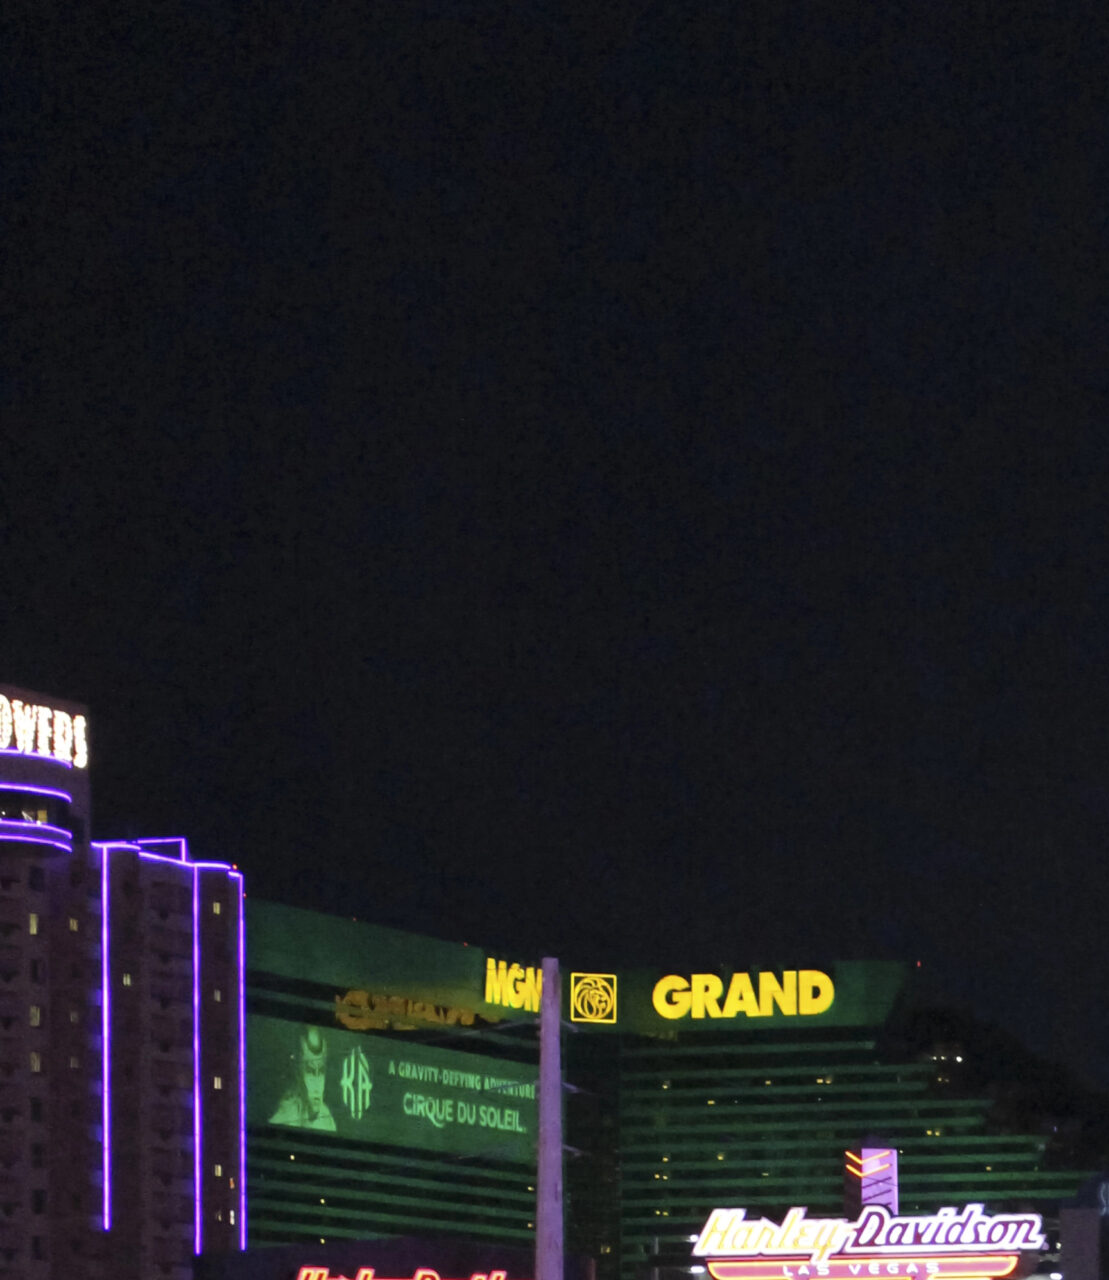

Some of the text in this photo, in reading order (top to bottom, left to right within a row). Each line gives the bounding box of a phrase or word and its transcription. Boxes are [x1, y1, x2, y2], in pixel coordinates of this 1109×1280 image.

[652, 969, 835, 1020] GRAND
[388, 1060, 396, 1075] A
[403, 1092, 454, 1128] CIRQUE
[457, 1101, 477, 1125] DU
[782, 1262, 941, 1276] LAS VEGAS
